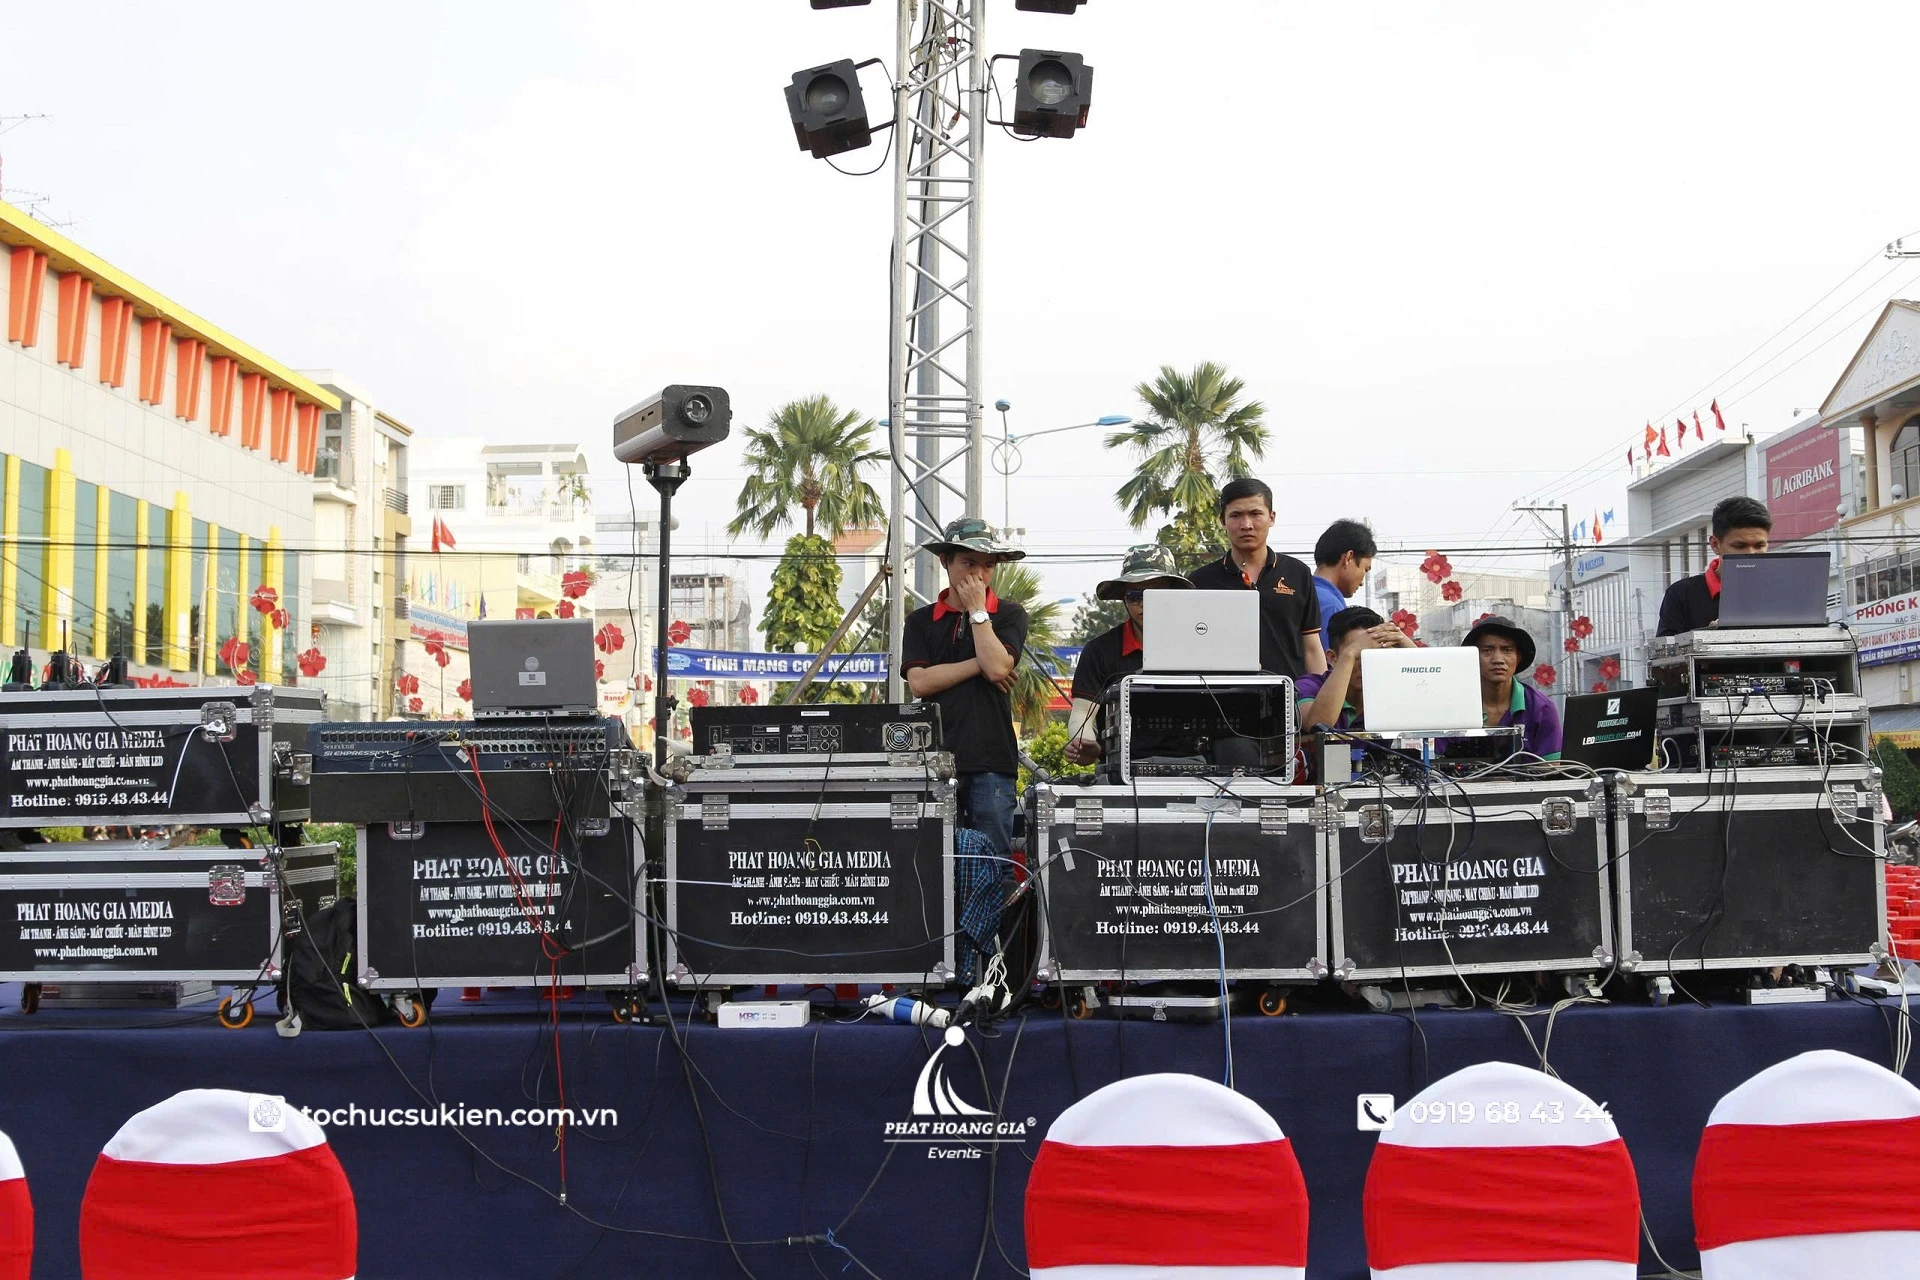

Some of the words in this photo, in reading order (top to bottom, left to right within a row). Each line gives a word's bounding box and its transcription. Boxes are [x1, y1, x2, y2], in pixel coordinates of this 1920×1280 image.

[1783, 459, 1835, 496] AGRIBANK
[743, 660, 788, 674] MẠNG
[46, 732, 92, 750] HOANG
[95, 732, 119, 750] GIA
[122, 730, 166, 748] MEDIA
[22, 758, 44, 770] THANH
[151, 756, 164, 766] LED
[11, 794, 71, 808] Hotline:
[728, 852, 764, 869] PHAT
[768, 852, 815, 869] HOANG
[818, 851, 844, 869] GIA
[846, 851, 892, 868] MEDIA
[413, 859, 462, 880] PHAT
[466, 856, 532, 879] HOANG
[1097, 860, 1132, 878] PHAT
[1138, 860, 1184, 878] HOANG
[1215, 860, 1260, 877] MEDIA
[1392, 864, 1440, 884] PHAT
[1446, 858, 1508, 881] HOANG
[1513, 856, 1545, 877] GIA
[878, 876, 889, 888] LED
[1190, 882, 1208, 896] CHIẾ
[1246, 884, 1258, 896] LED
[1528, 884, 1539, 898] LED
[17, 903, 50, 921] PHAT
[54, 902, 100, 920] HOANG
[103, 902, 126, 920] GIA
[130, 901, 174, 919] MEDIA
[730, 912, 790, 924] Hotline:
[795, 912, 888, 924] 0919.43.43.44
[31, 928, 52, 940] THANH
[160, 926, 172, 938] LED
[412, 924, 474, 939] Hotline:
[478, 920, 572, 936] 0919.43.43.4
[1096, 922, 1158, 934] Hotline:
[1164, 922, 1260, 934] 0919.4343.44
[34, 945, 158, 960] www.phathoanggia.com.vn
